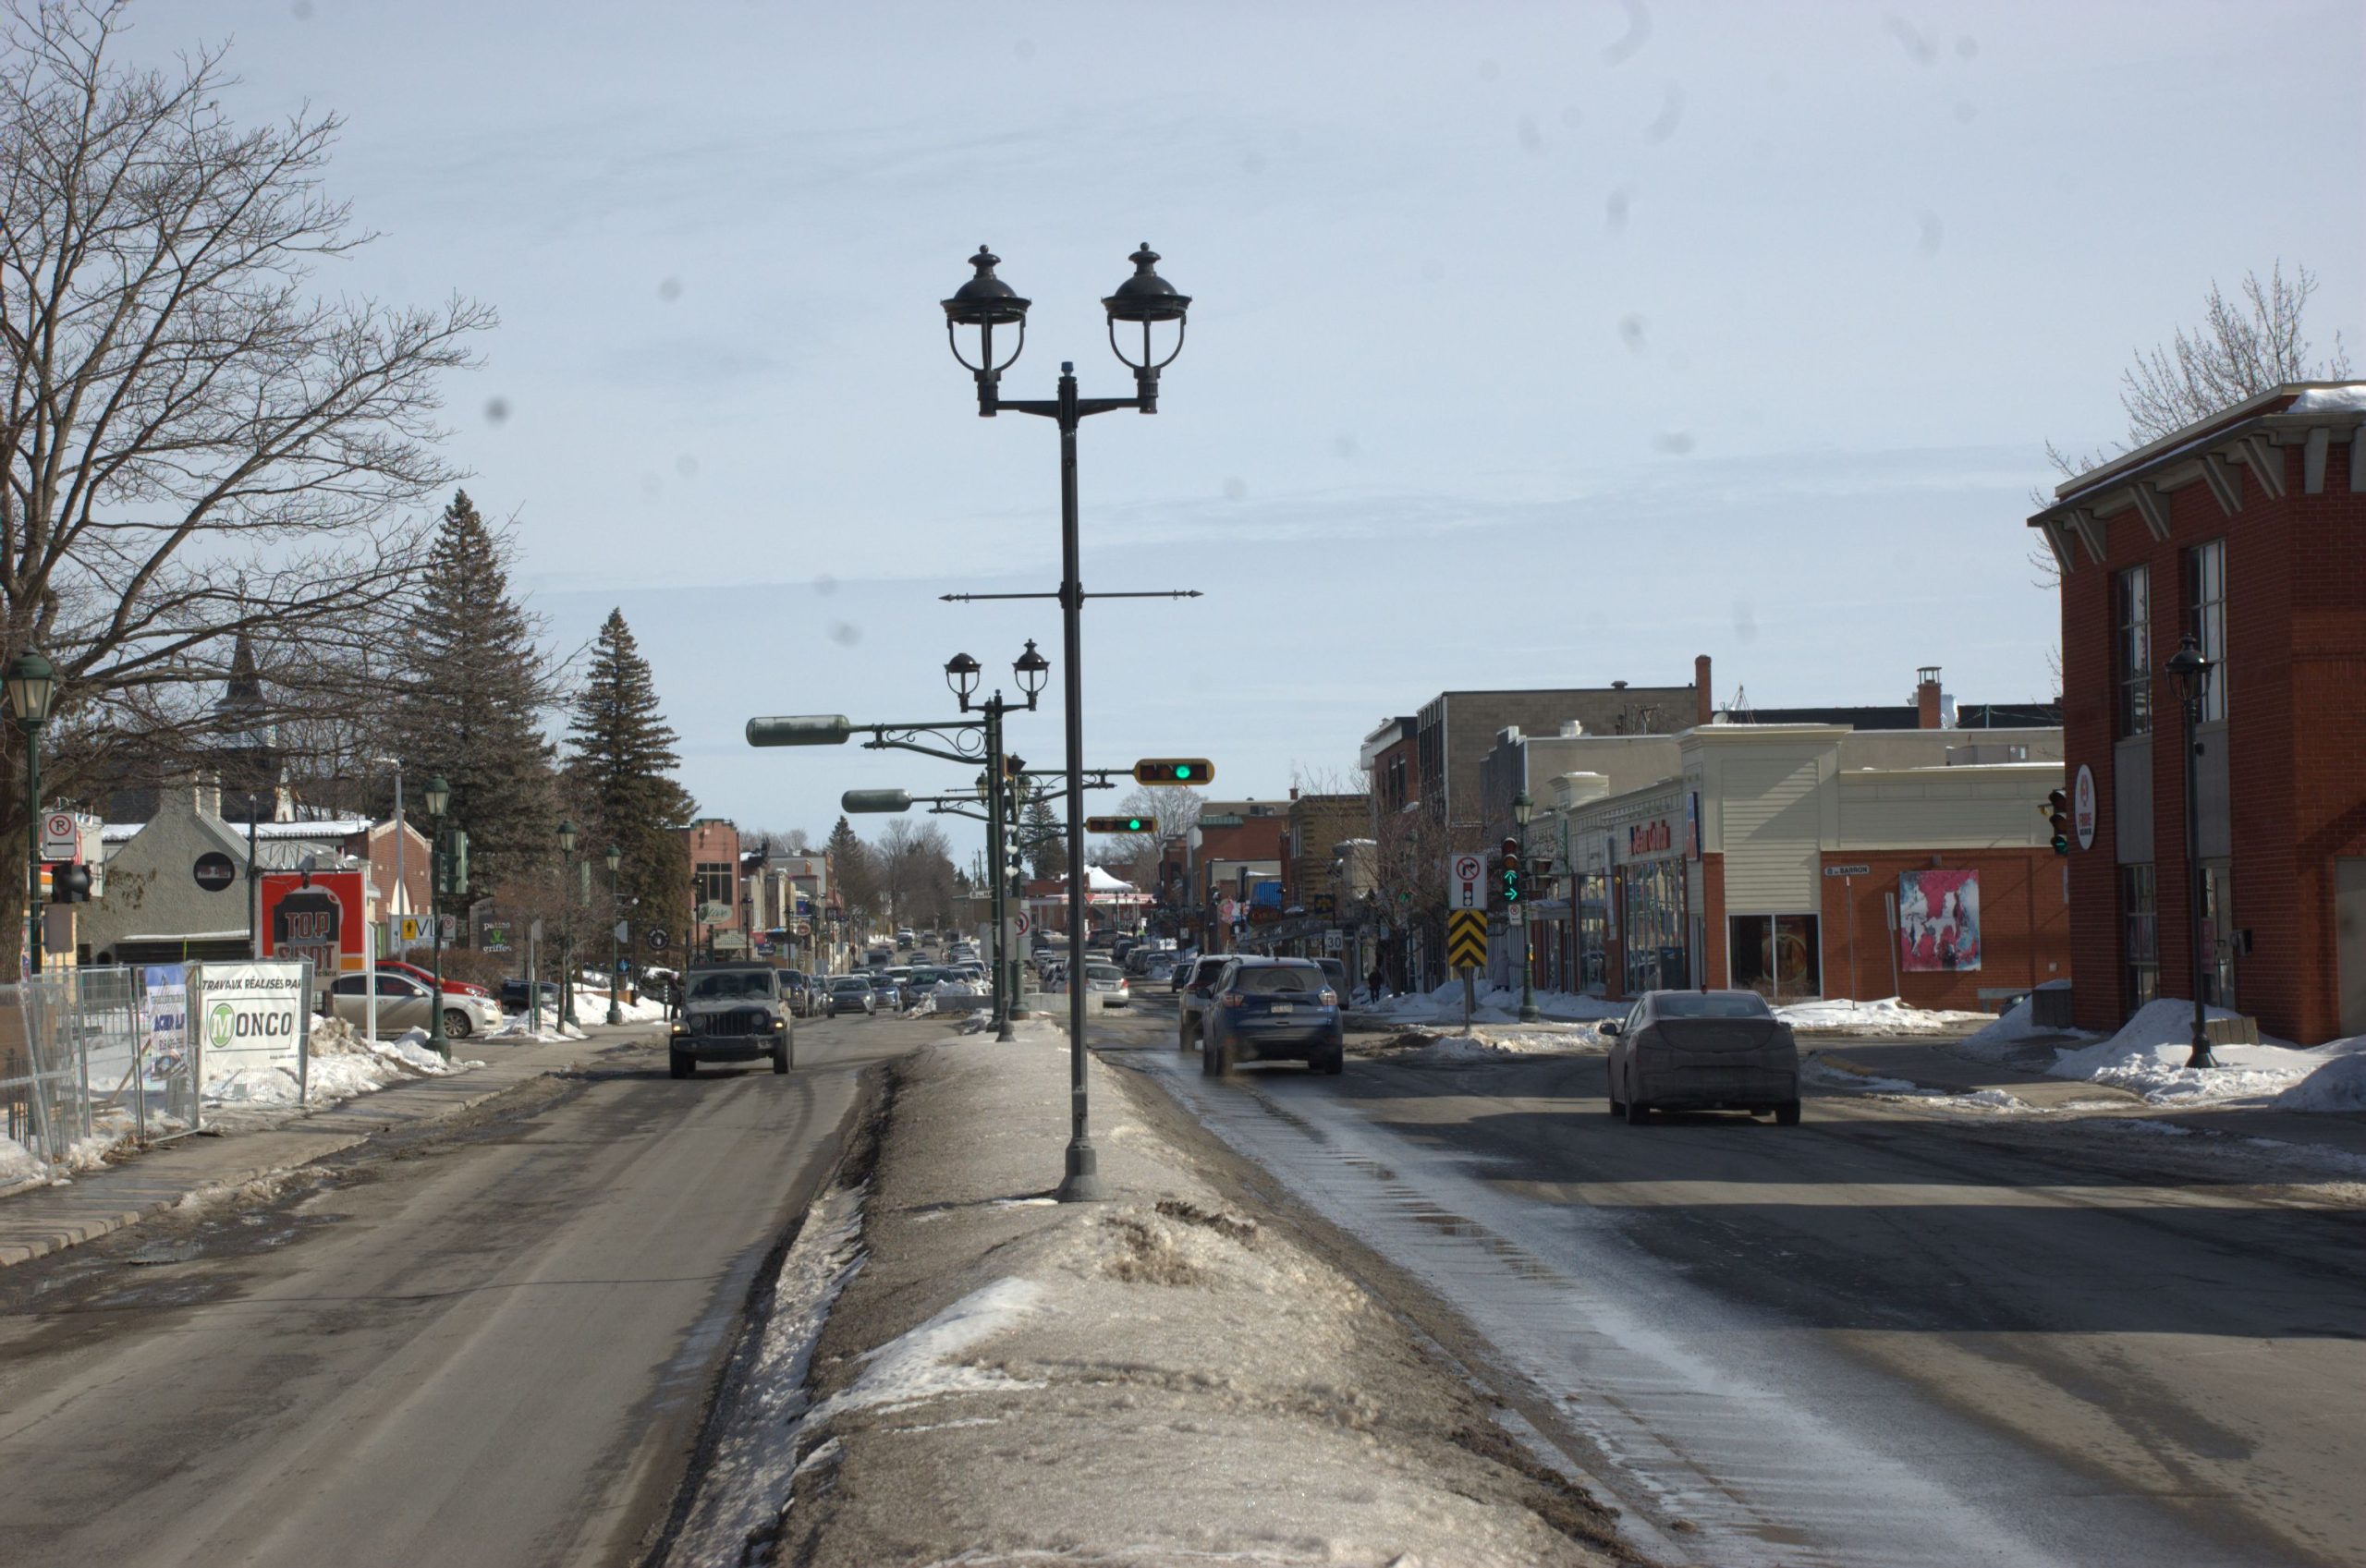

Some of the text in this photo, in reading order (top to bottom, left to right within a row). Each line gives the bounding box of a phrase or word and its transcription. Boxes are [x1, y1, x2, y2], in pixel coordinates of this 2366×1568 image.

[1839, 866, 1868, 874] BARRON
[285, 912, 331, 939] TOP
[1327, 937, 1341, 948] 30
[201, 978, 242, 991] TRAVAUX
[244, 976, 285, 990] RÉALISÉS
[212, 1012, 293, 1038] MONCO
